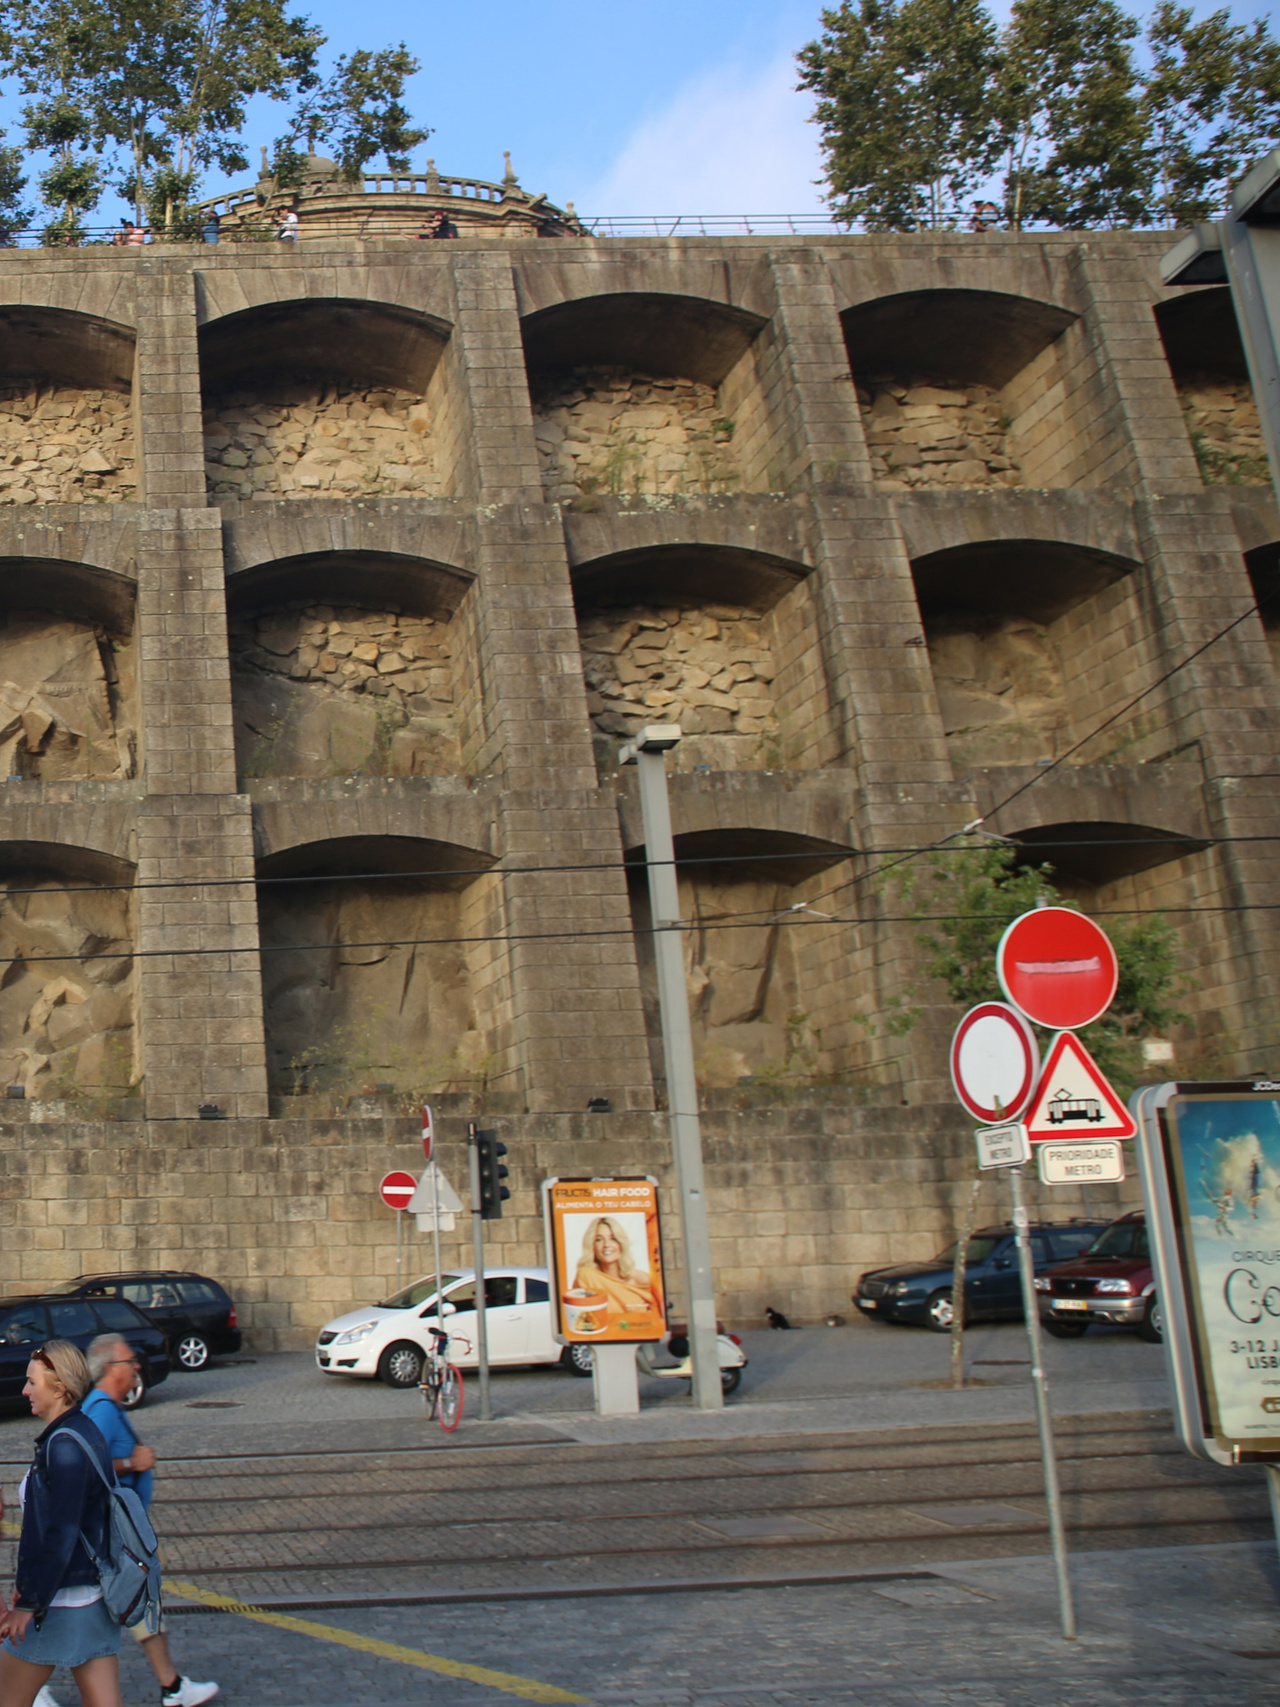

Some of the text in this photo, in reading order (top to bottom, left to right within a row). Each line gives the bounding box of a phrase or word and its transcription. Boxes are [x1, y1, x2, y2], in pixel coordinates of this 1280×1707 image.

[1049, 1148, 1115, 1161] PRIORIDADE
[1064, 1164, 1102, 1176] METRO
[556, 1187, 650, 1197] FRUCTIS HAIR FOOD
[556, 1201, 594, 1209] ALIMENTA
[620, 1200, 651, 1208] CABELO
[1230, 1340, 1266, 1353] 3-12
[1246, 1356, 1280, 1369] LISB
